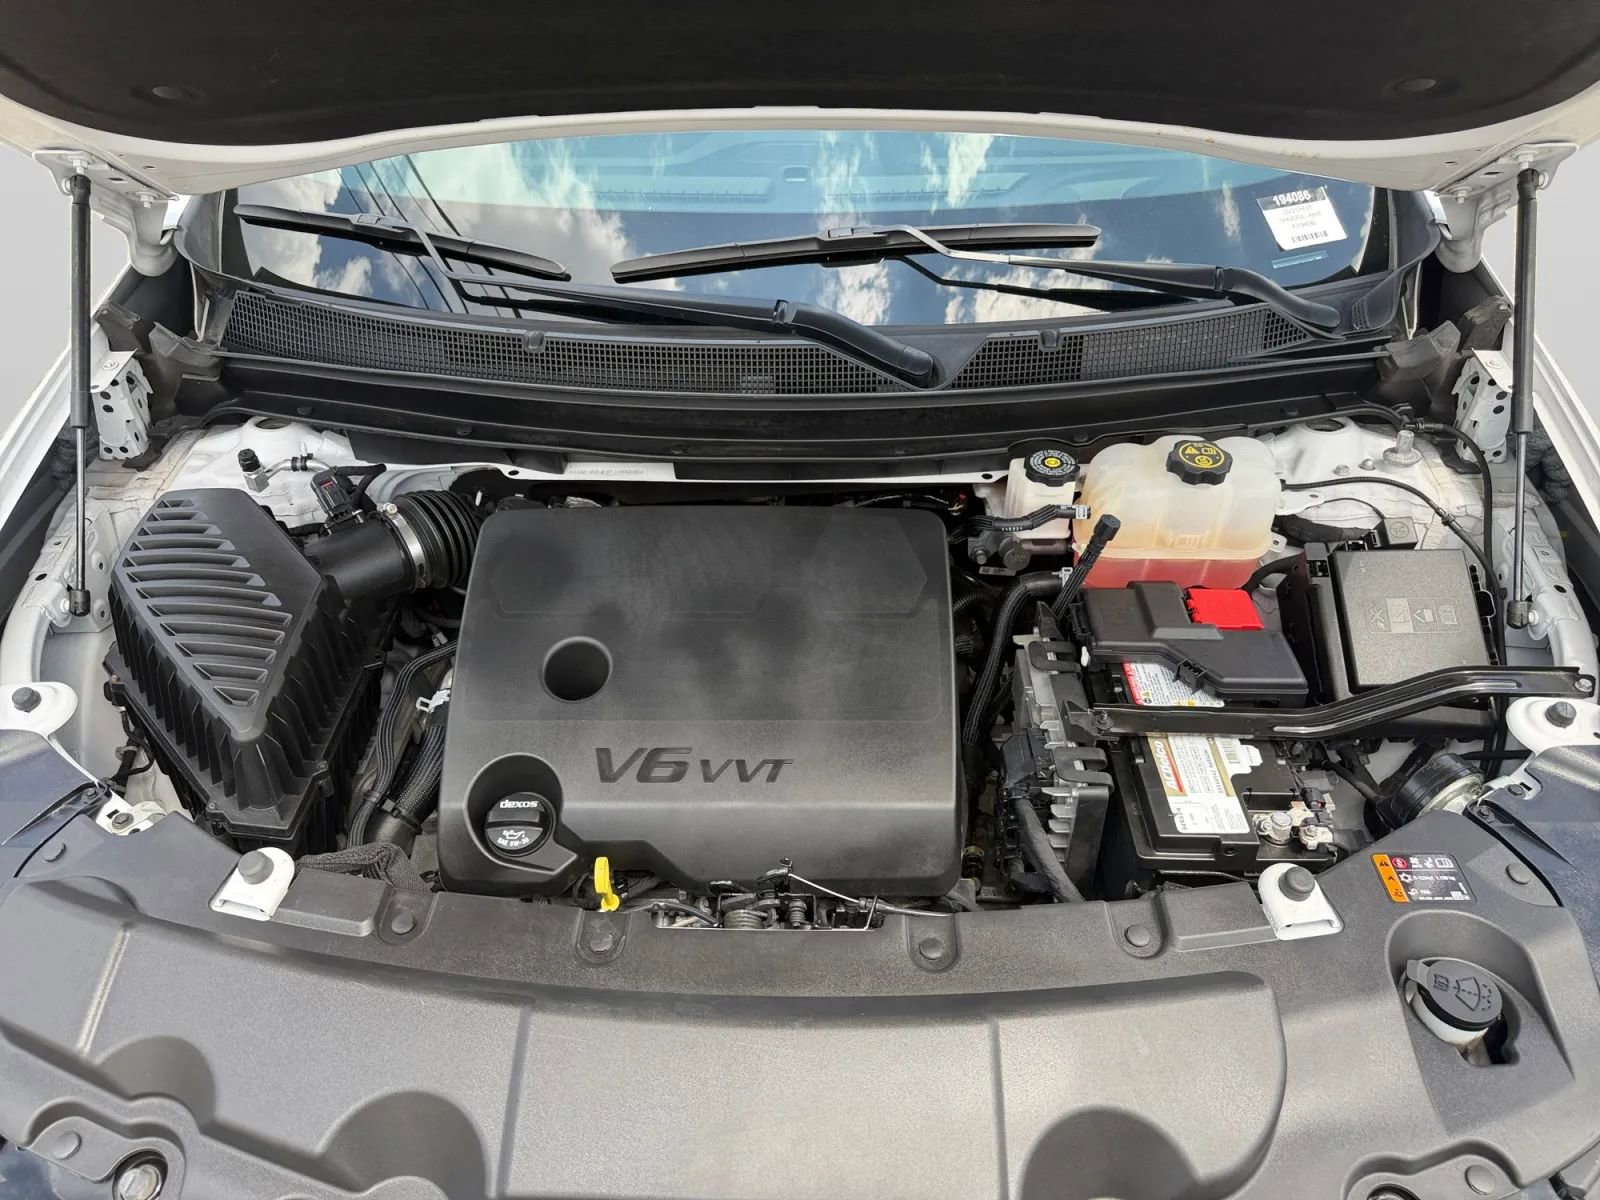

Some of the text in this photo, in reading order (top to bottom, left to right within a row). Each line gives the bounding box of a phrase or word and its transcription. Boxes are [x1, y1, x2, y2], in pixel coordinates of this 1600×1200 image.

[595, 747, 795, 784] V6 VVT
[499, 799, 540, 809] dexos
